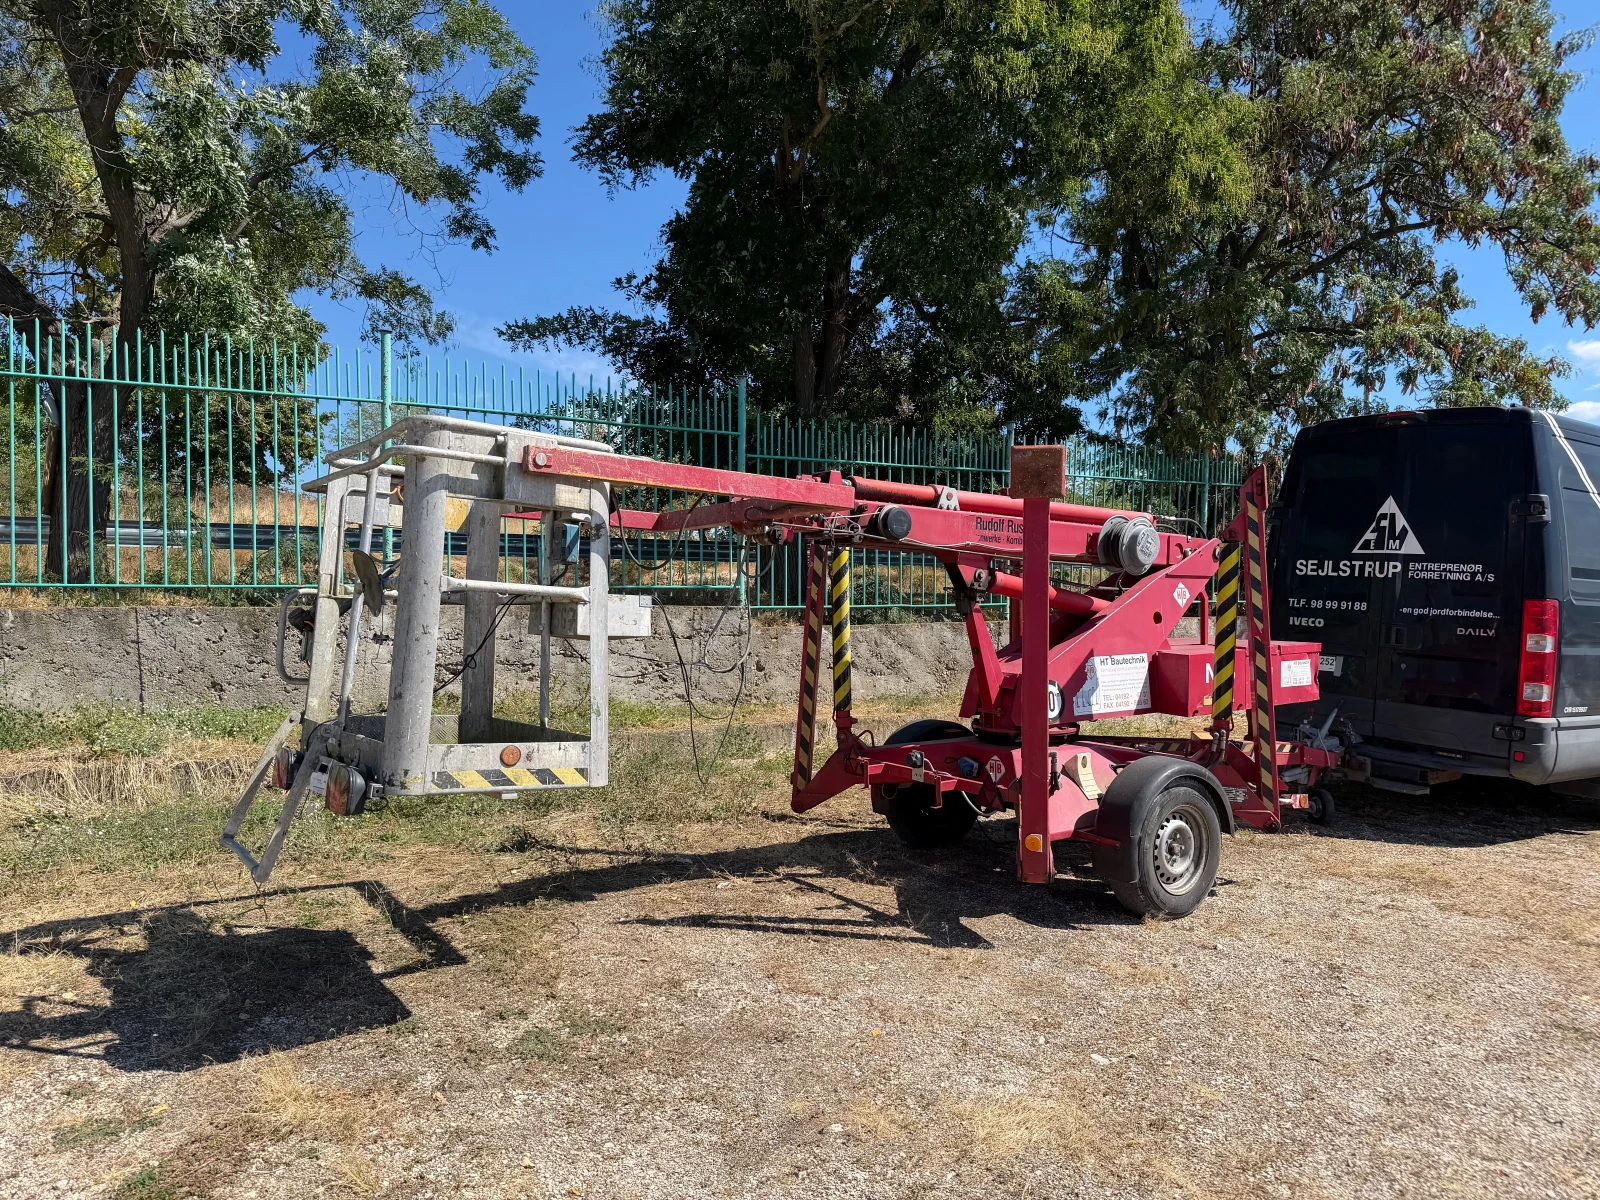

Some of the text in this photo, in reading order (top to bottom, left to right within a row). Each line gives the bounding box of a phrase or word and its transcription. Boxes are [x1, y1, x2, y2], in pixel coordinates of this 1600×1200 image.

[975, 517, 1004, 532] Rudolf
[1295, 559, 1483, 578] SEJLSTRUP ENTREPRENØR
[1408, 571, 1495, 582] FORRETNING A/S
[1288, 598, 1308, 608] TLF.
[1310, 600, 1323, 609] 98
[1325, 600, 1338, 609] 99
[1413, 607, 1429, 616] god
[1429, 608, 1500, 618] jordforbindelse...
[1289, 617, 1324, 627] IVECO
[1457, 628, 1495, 636] DAILY
[1100, 655, 1146, 666] HT Bautechnik
[1103, 702, 1114, 710] FAX
[990, 758, 1002, 781] HTB
